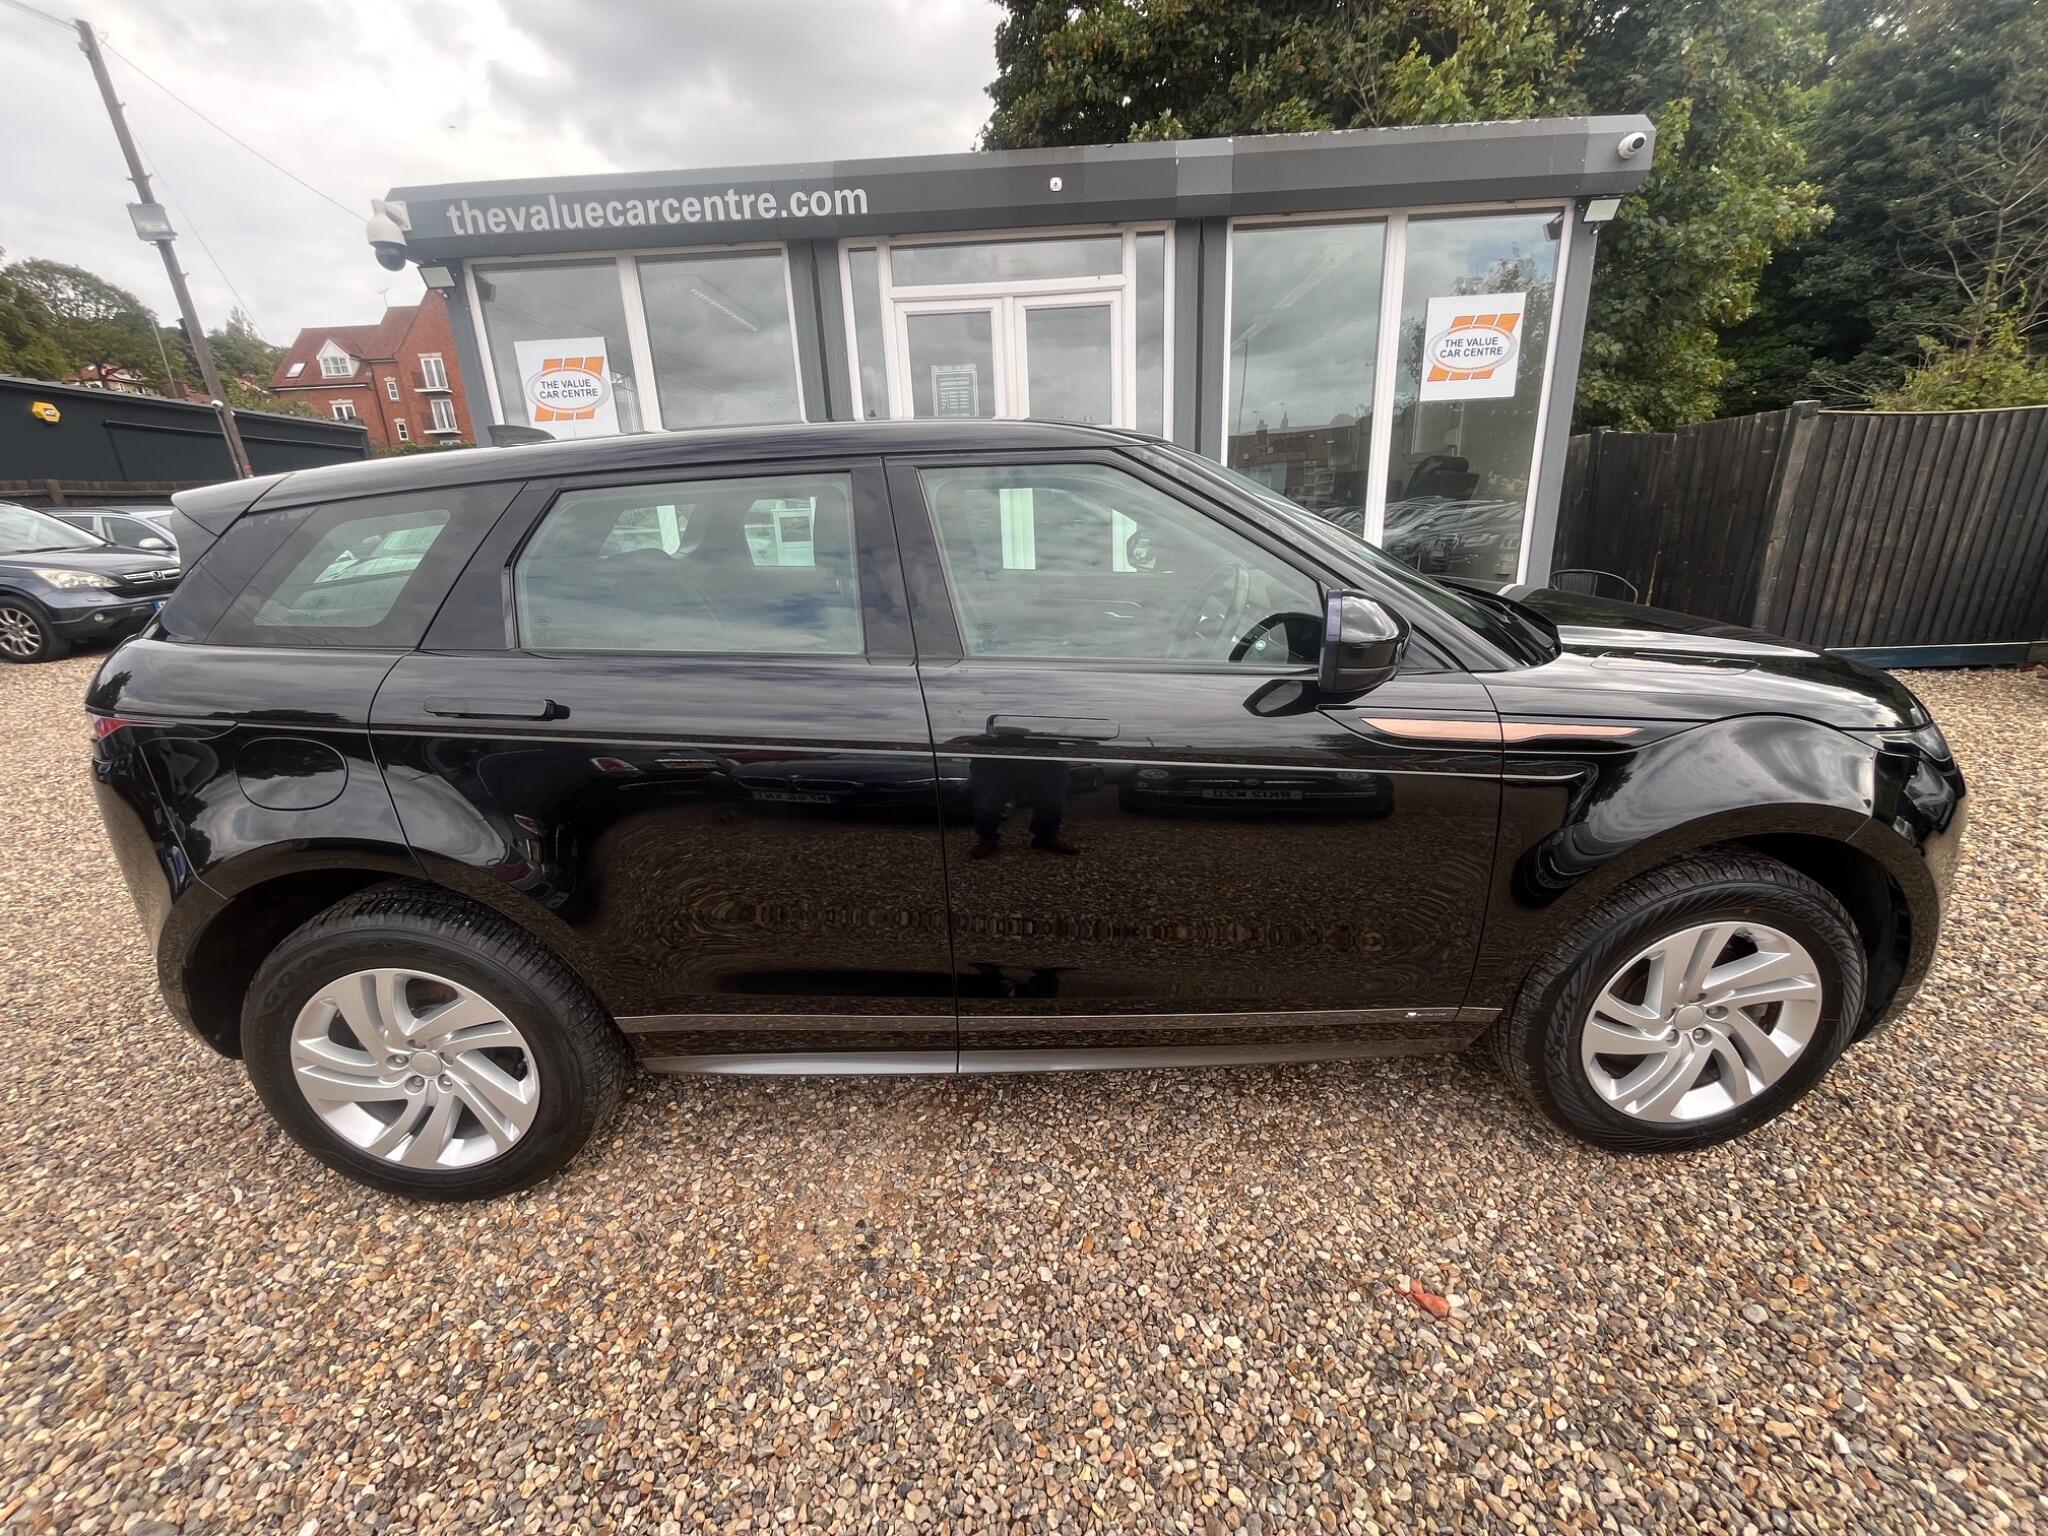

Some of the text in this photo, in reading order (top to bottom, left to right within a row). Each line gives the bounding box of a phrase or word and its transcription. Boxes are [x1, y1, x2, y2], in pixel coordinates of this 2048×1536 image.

[446, 187, 868, 235] thevaluecarcentre.com
[1445, 336, 1499, 348] THE VALUE
[1439, 346, 1503, 358] CAR CENTRE
[541, 379, 592, 389] THE VALUE
[539, 388, 599, 399] CAR CENTRE
